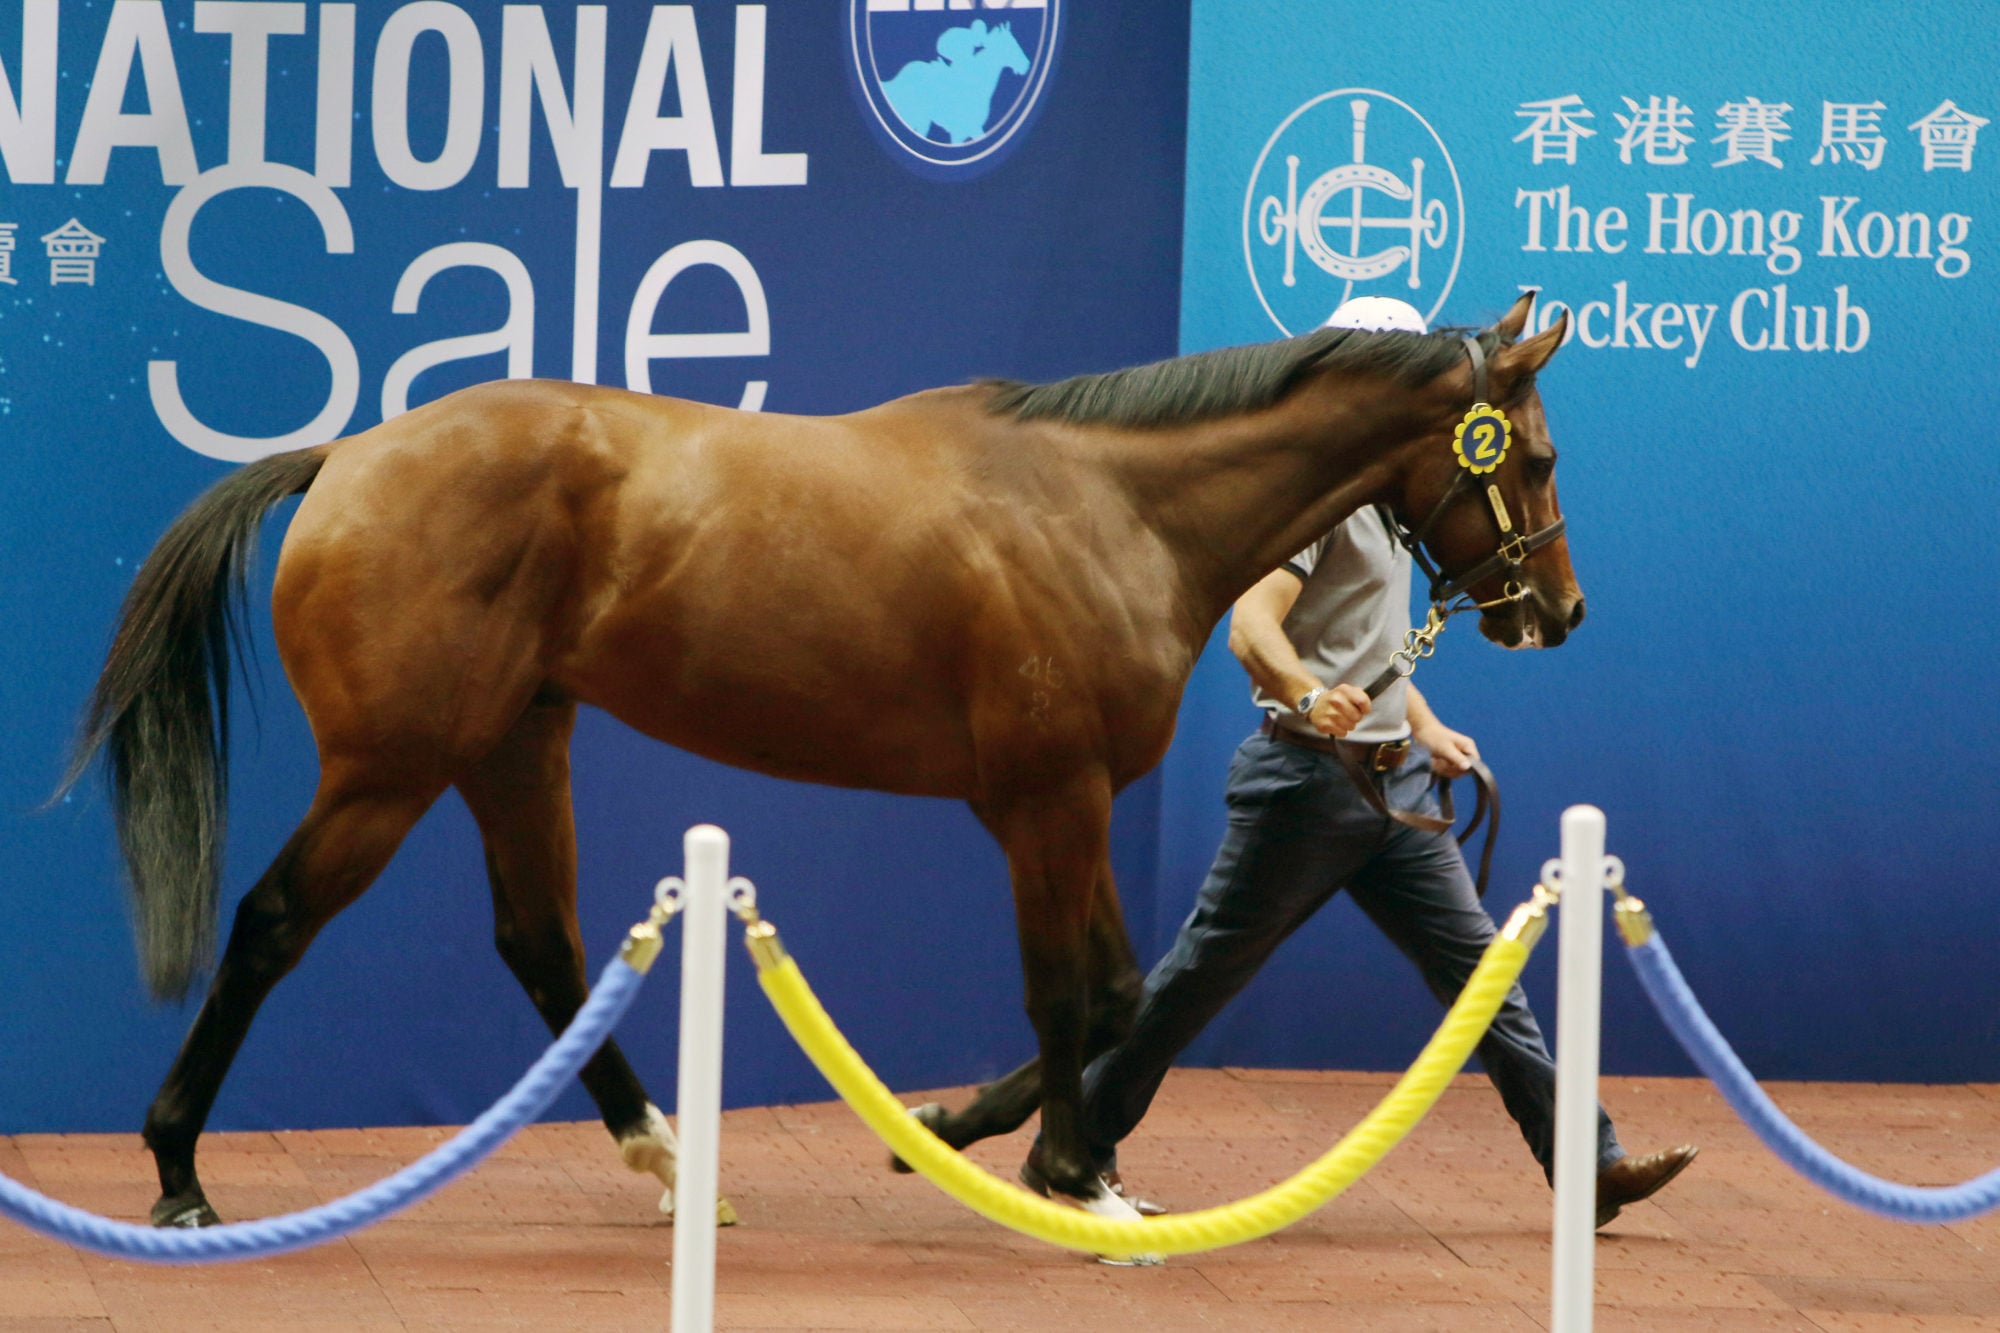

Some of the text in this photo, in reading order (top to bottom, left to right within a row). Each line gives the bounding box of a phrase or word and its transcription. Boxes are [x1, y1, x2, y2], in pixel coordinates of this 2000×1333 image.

[1512, 94, 1991, 172] 香港賽馬會
[1514, 184, 1972, 279] The Hong Kong
[147, 161, 771, 463] Sale
[1517, 280, 1871, 369] Jockey Club
[1472, 423, 1497, 460] 2
